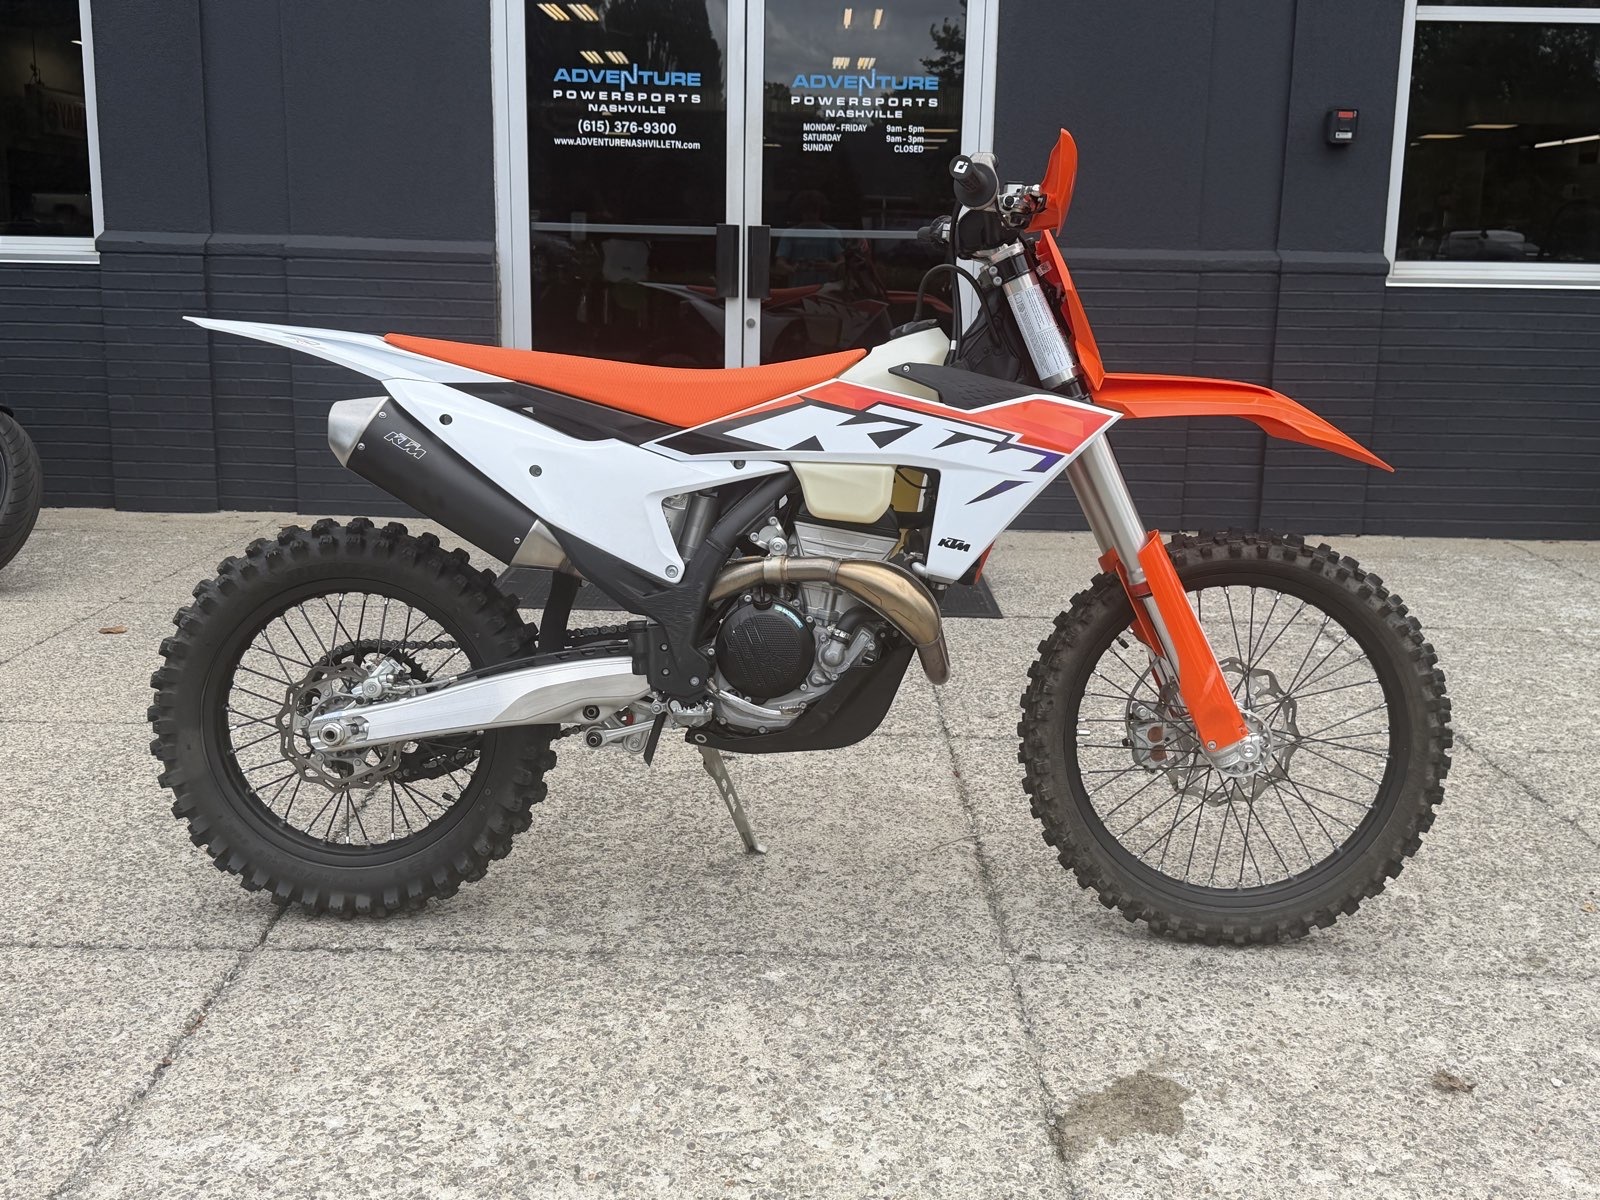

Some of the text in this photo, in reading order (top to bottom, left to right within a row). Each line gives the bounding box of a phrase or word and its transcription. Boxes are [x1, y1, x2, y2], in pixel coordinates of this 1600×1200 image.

[554, 63, 701, 91] ADVENTURE
[792, 68, 939, 96] ADVENTURE
[553, 90, 701, 103] POWERSPORTS
[791, 96, 938, 107] POWERSPORTS
[588, 103, 666, 114] NASHVILLE
[825, 110, 903, 119] NASHVILLE
[578, 119, 677, 135] (615) 376-9300
[803, 123, 836, 132] MONDAY
[841, 124, 868, 132] FRIDAY
[886, 125, 903, 133] 9am
[908, 125, 925, 135] 5pm
[554, 137, 701, 150] www.ADVENTURENASHVILLETN.com
[802, 133, 842, 142] SATURDAY
[886, 135, 902, 143] 9am
[908, 135, 924, 144] 3pm
[802, 143, 924, 153] SUNDAY CLOSED
[384, 431, 427, 460] KTM
[938, 536, 972, 553] KTM
